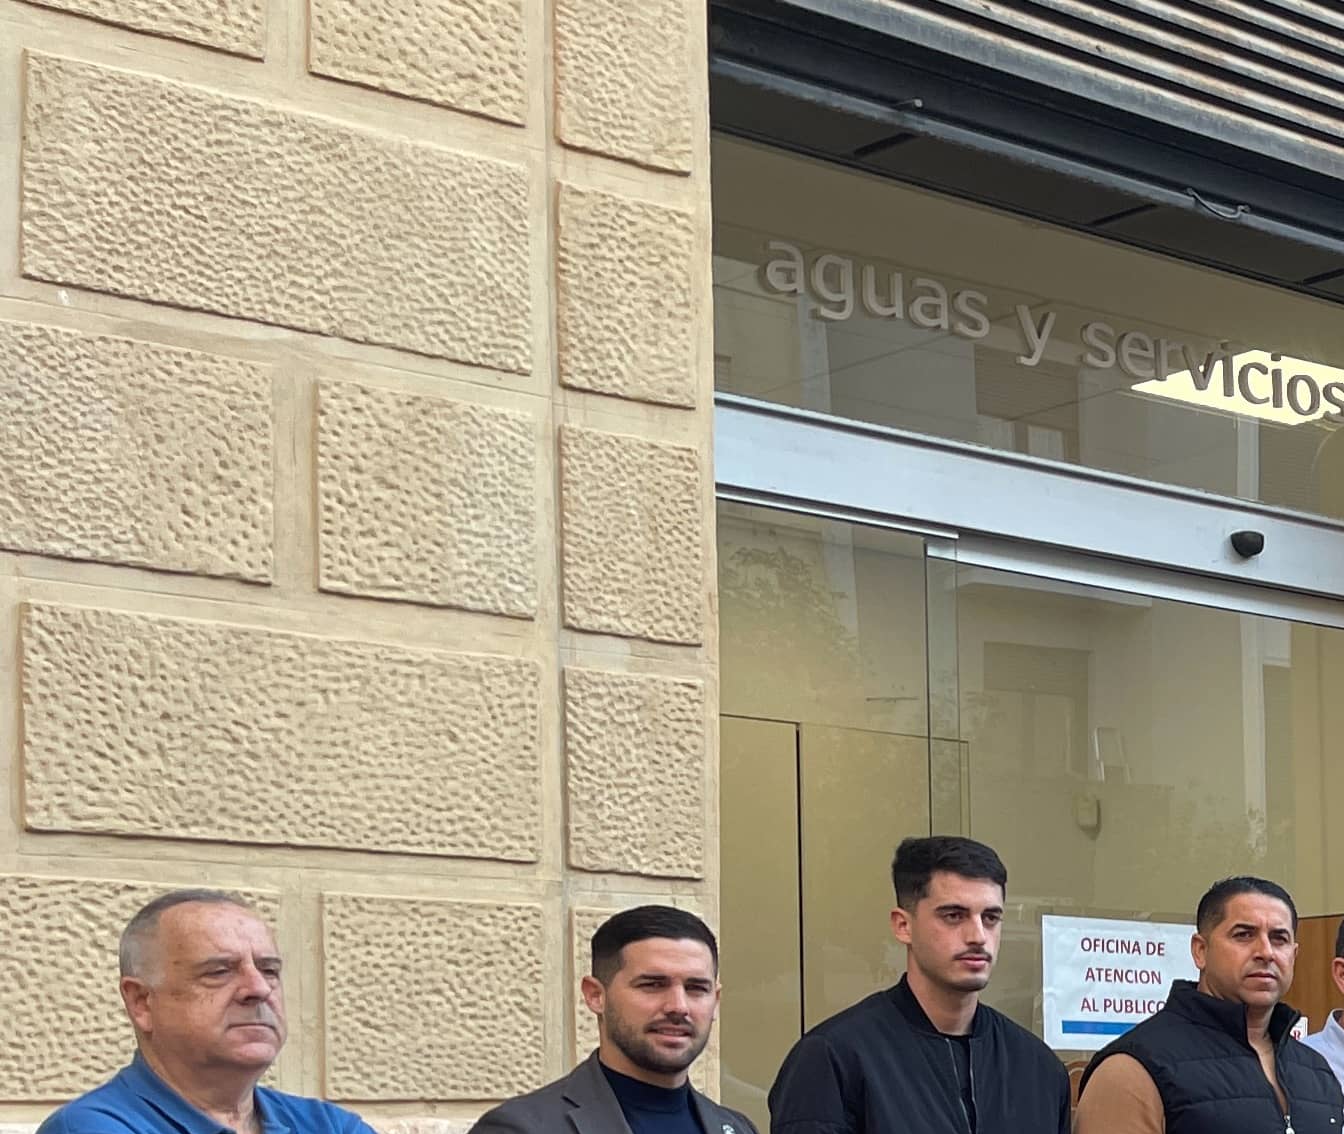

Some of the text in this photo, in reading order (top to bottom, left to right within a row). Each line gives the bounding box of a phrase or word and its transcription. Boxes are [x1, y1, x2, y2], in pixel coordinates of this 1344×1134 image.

[765, 241, 990, 338] aguas
[1016, 304, 1056, 366] y
[1081, 937, 1165, 956] OFICINA DE
[1085, 967, 1162, 985] ATENCION
[1081, 997, 1166, 1014] AL PUBLICO
